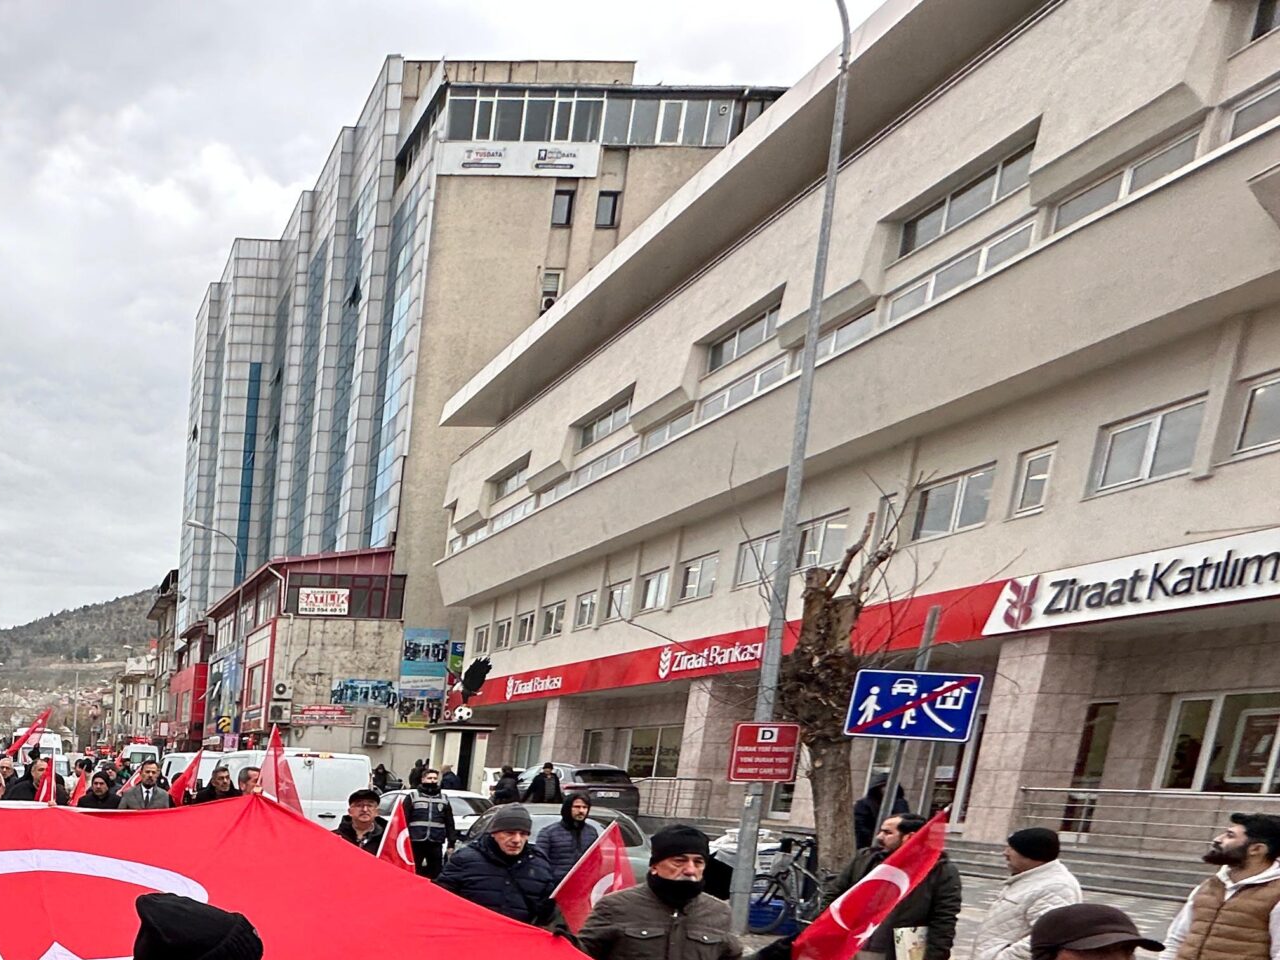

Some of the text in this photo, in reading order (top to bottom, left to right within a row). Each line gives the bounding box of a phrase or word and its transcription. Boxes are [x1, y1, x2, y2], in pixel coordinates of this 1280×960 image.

[1042, 549, 1280, 616] Ziraat Katılım
[299, 592, 350, 605] SATILIK
[671, 641, 763, 672] Ziraat Bankası
[513, 675, 562, 695] Ziraat Bankası
[760, 729, 774, 740] D
